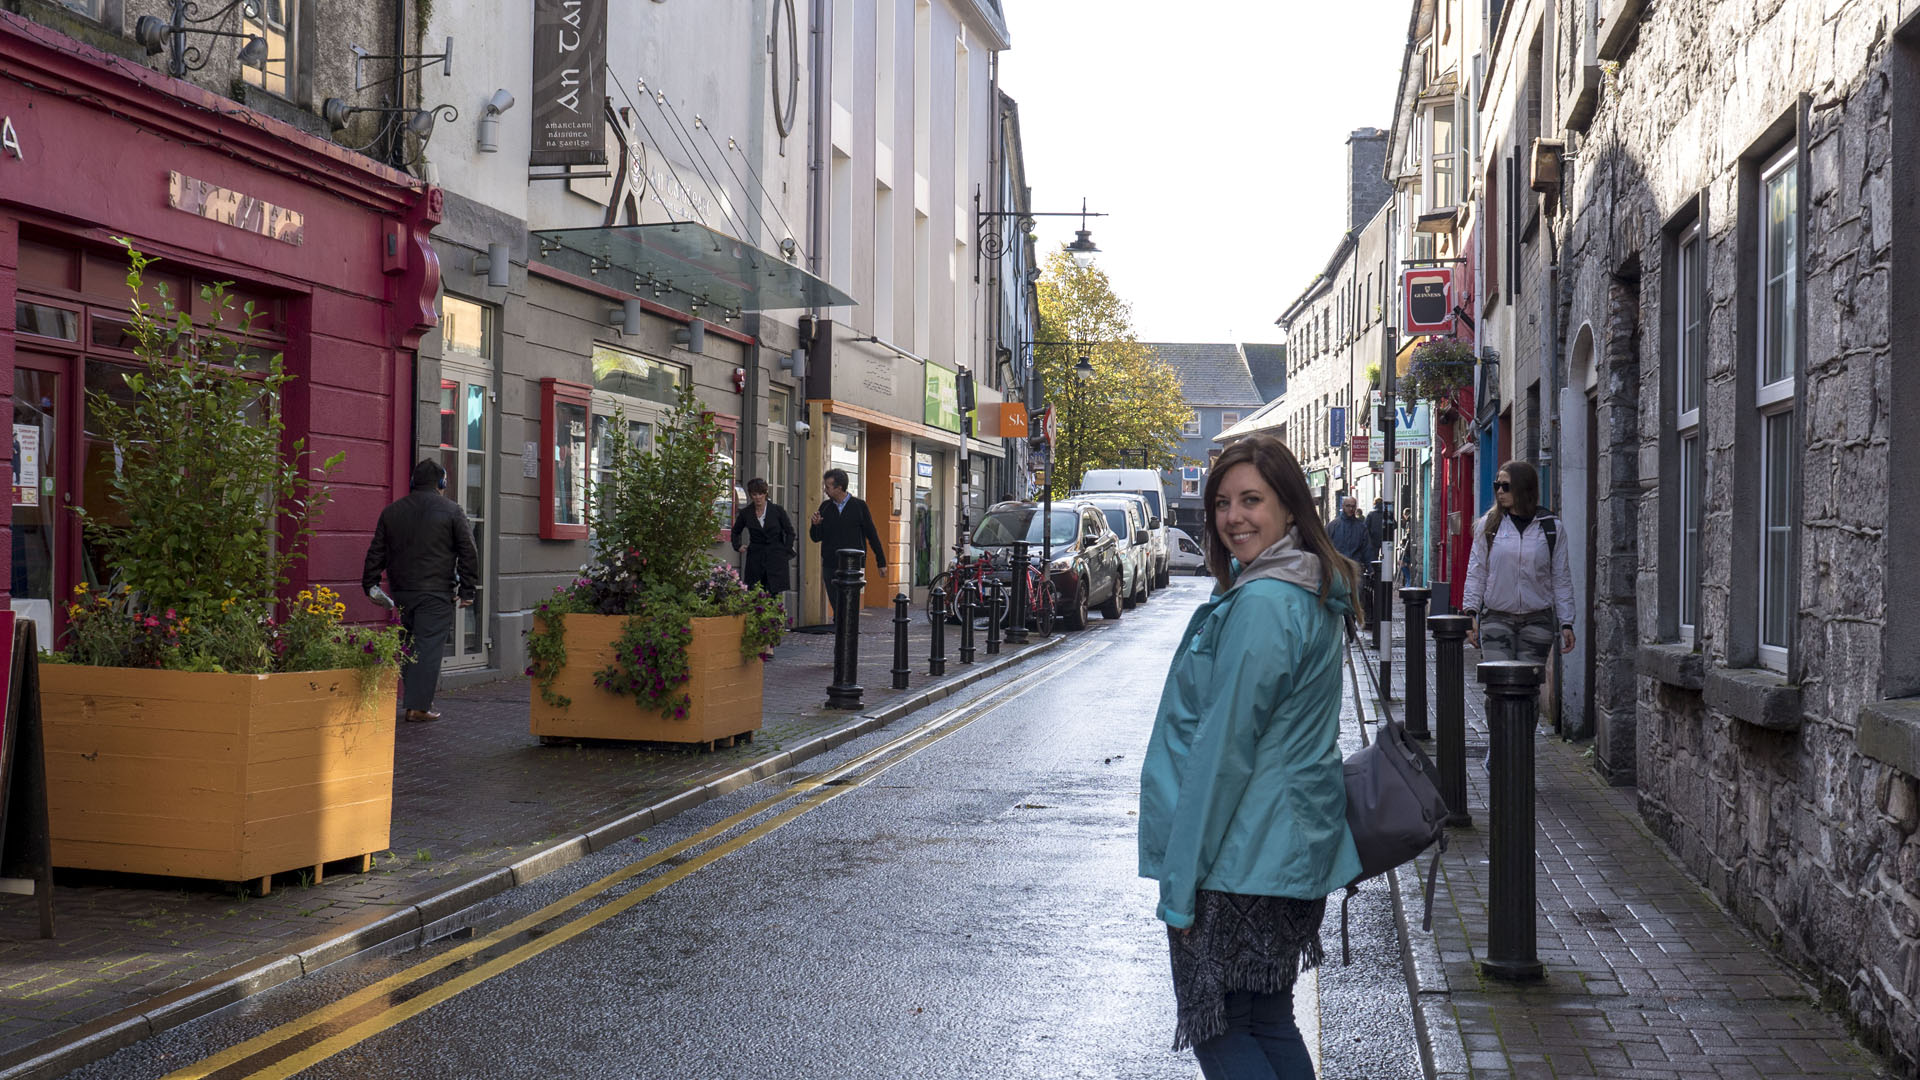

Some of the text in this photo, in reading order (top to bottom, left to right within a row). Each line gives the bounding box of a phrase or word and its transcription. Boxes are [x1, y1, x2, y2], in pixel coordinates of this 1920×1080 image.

[556, 69, 580, 114] An
[169, 172, 304, 226] RESTAURANT
[269, 225, 304, 246] BAR
